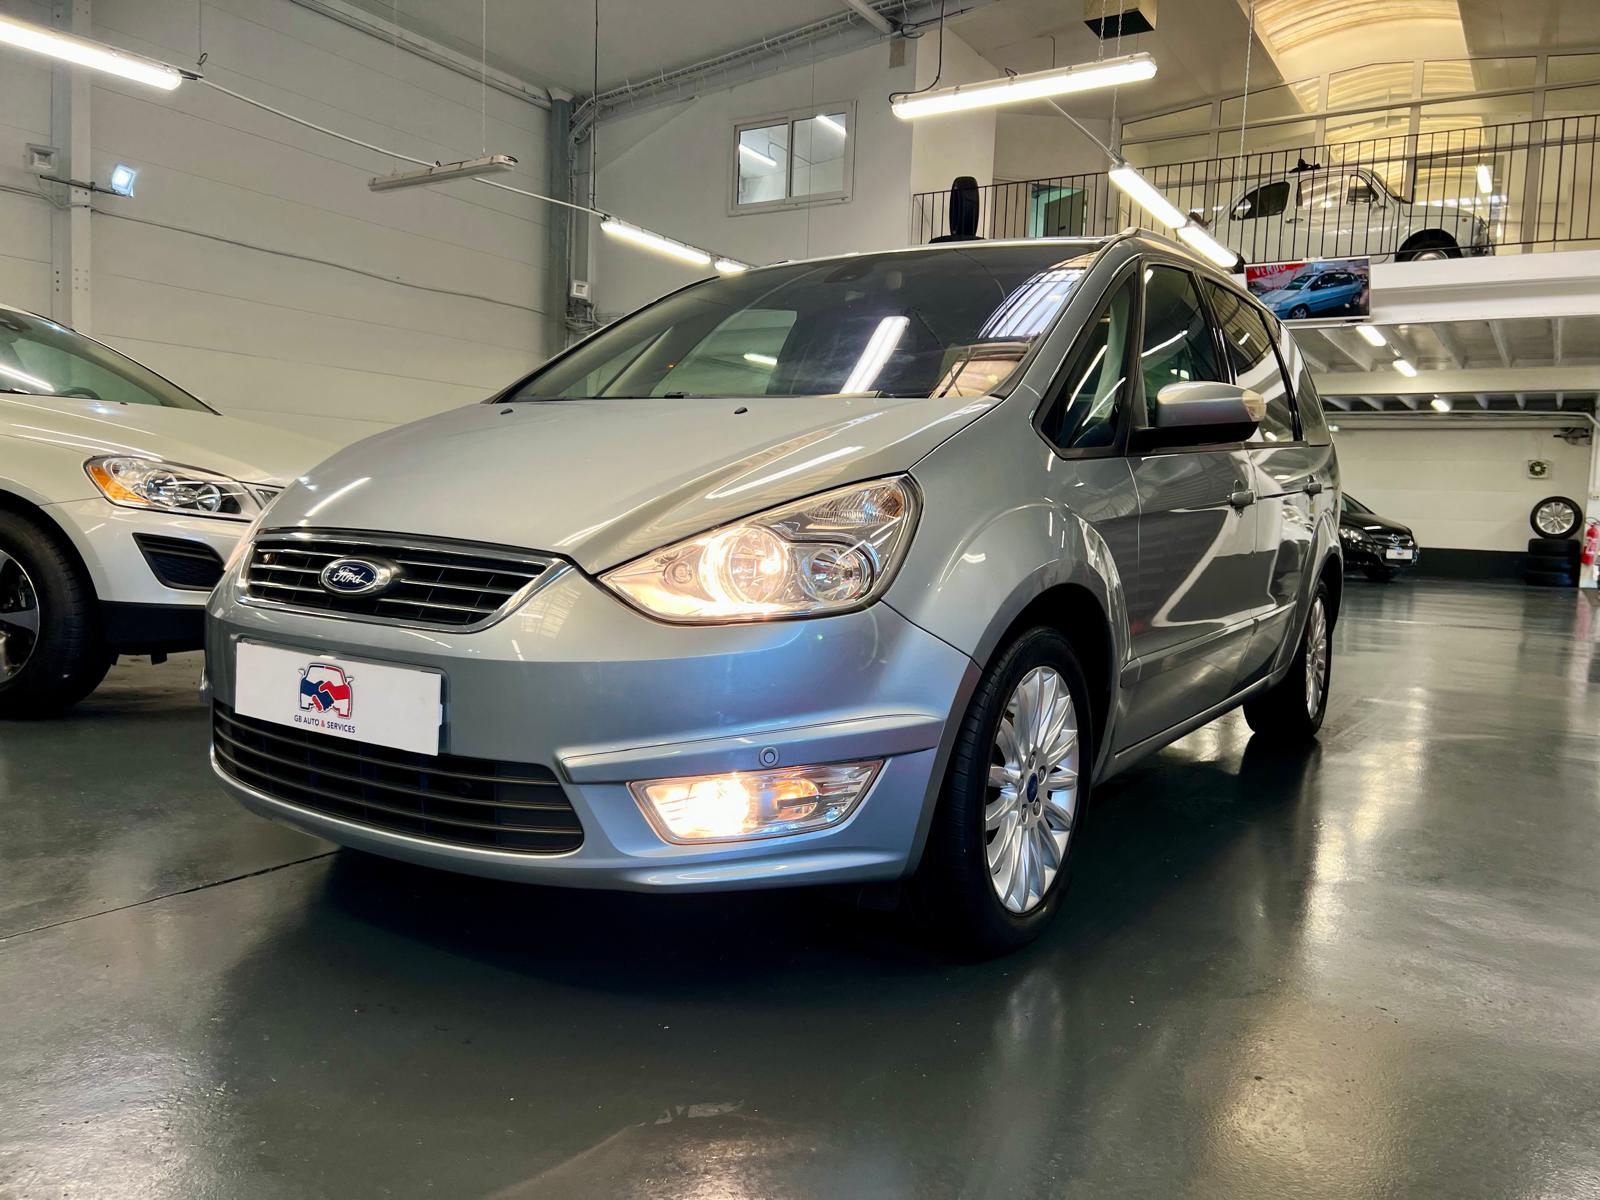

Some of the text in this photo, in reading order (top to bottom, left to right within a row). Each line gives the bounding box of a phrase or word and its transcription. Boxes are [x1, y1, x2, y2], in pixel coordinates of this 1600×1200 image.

[332, 565, 370, 586] Ford
[294, 714, 302, 723] GB
[303, 716, 320, 726] AUTO
[326, 721, 356, 734] SERVICES
